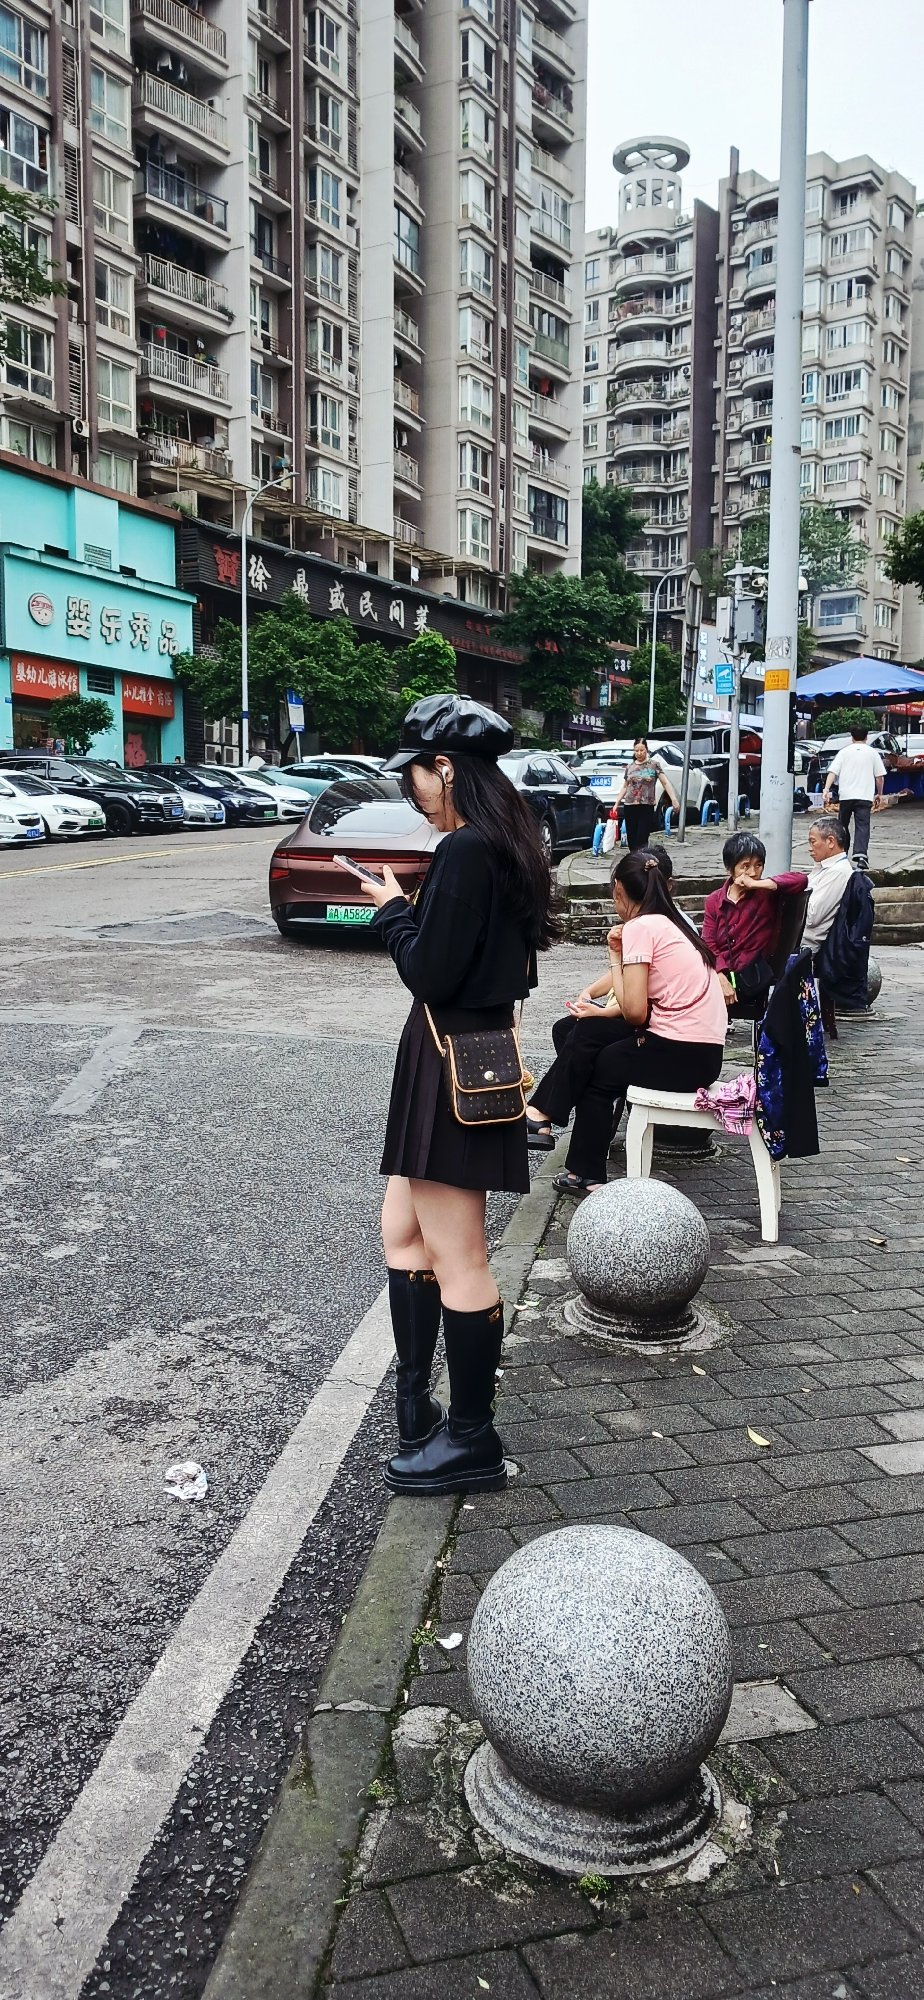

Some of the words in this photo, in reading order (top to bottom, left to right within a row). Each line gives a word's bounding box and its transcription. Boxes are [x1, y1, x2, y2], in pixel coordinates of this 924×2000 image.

[248, 554, 430, 634] 徐鼎盛民间菜
[66, 596, 179, 655] 婴乐秀品
[16, 662, 78, 692] 婴幼儿游泳馆
[123, 684, 155, 706] 小儿推拿
[343, 908, 376, 920] A5822
